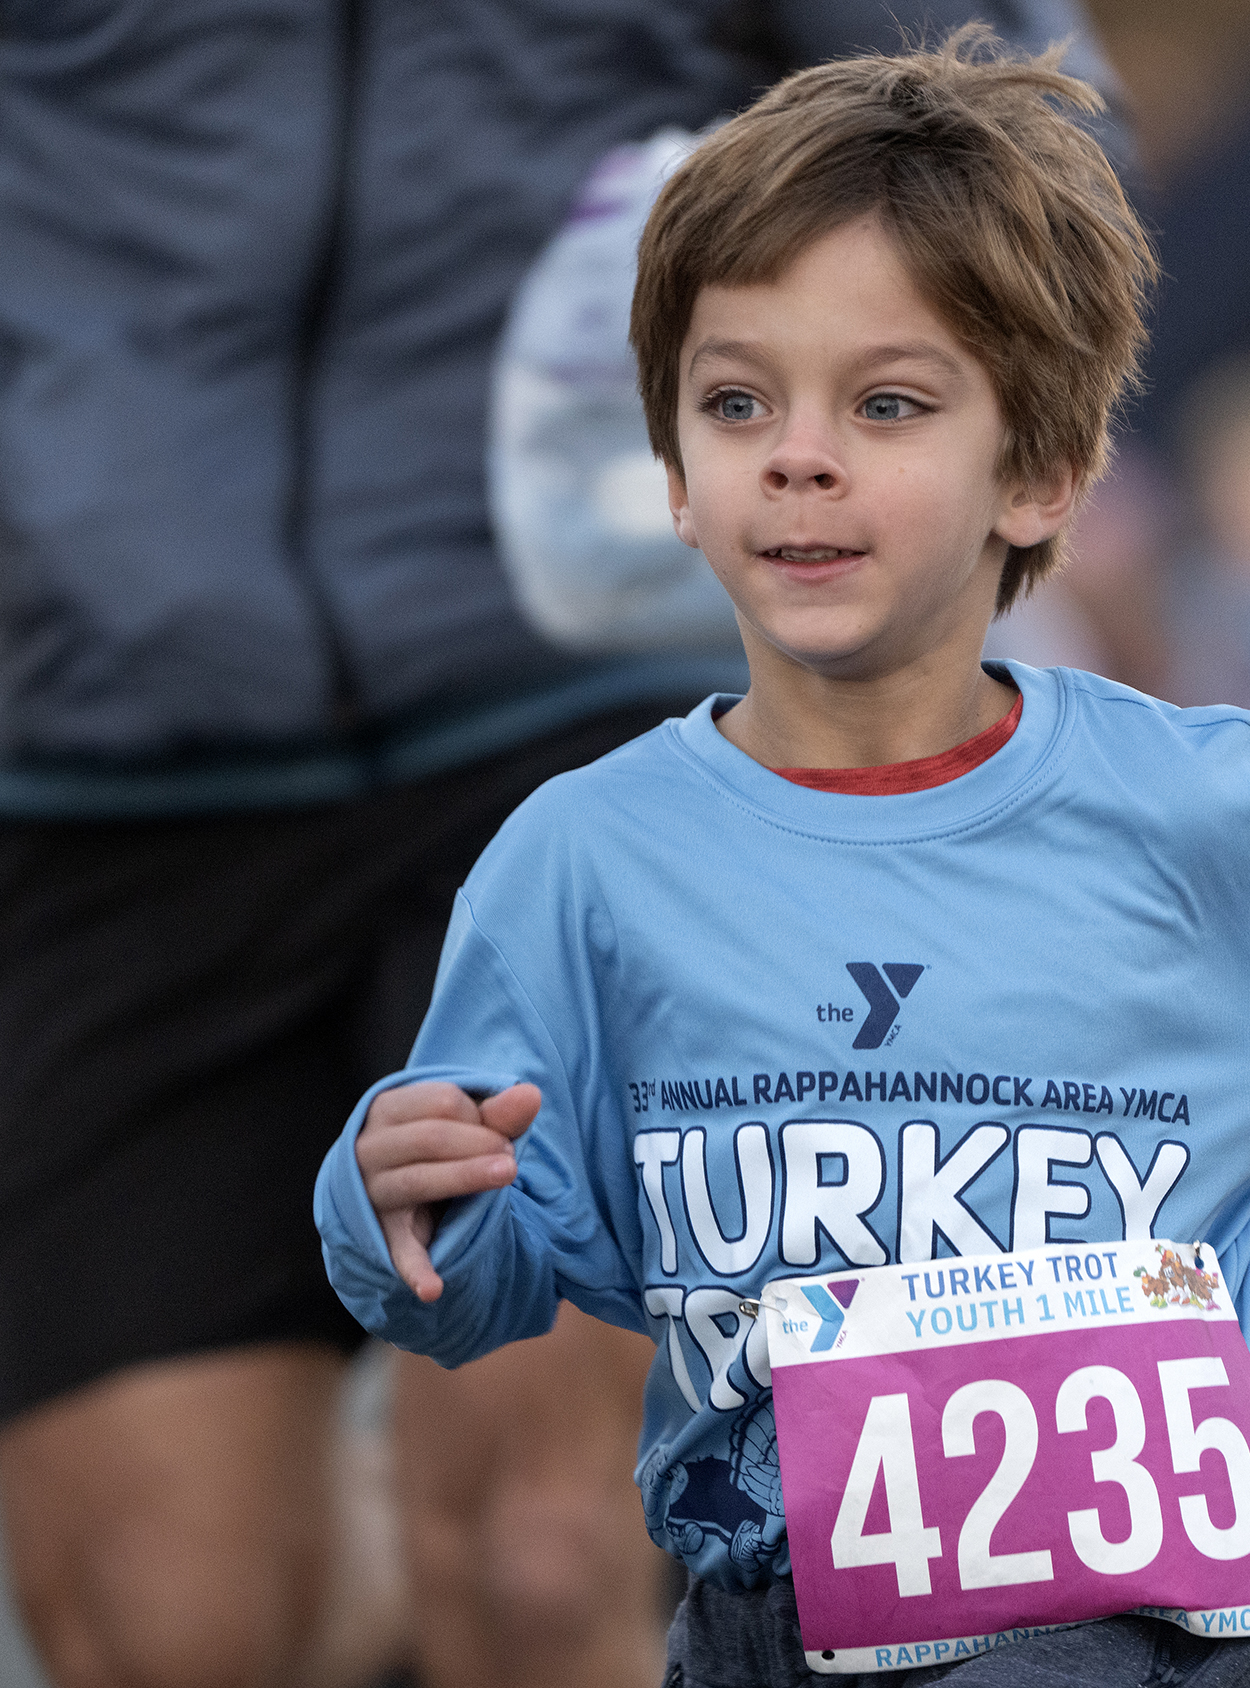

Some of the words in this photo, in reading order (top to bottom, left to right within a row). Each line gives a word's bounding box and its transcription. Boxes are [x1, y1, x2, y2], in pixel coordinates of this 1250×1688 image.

[816, 1002, 854, 1022] the
[884, 1023, 902, 1048] YMCA
[661, 1075, 747, 1111] ANNUAL
[753, 1070, 1034, 1107] RAPPAHANNOCK
[1040, 1079, 1114, 1115] AREA
[1119, 1086, 1190, 1126] YMCA
[633, 1119, 1191, 1278] TURKEY
[901, 1259, 1035, 1302] TURKEY
[1046, 1251, 1118, 1284] TROT
[782, 1318, 809, 1335] the
[906, 1297, 1025, 1338] YOUTH
[1036, 1293, 1055, 1321] 1
[1063, 1286, 1135, 1319] MILE
[1123, 1606, 1190, 1628] REA
